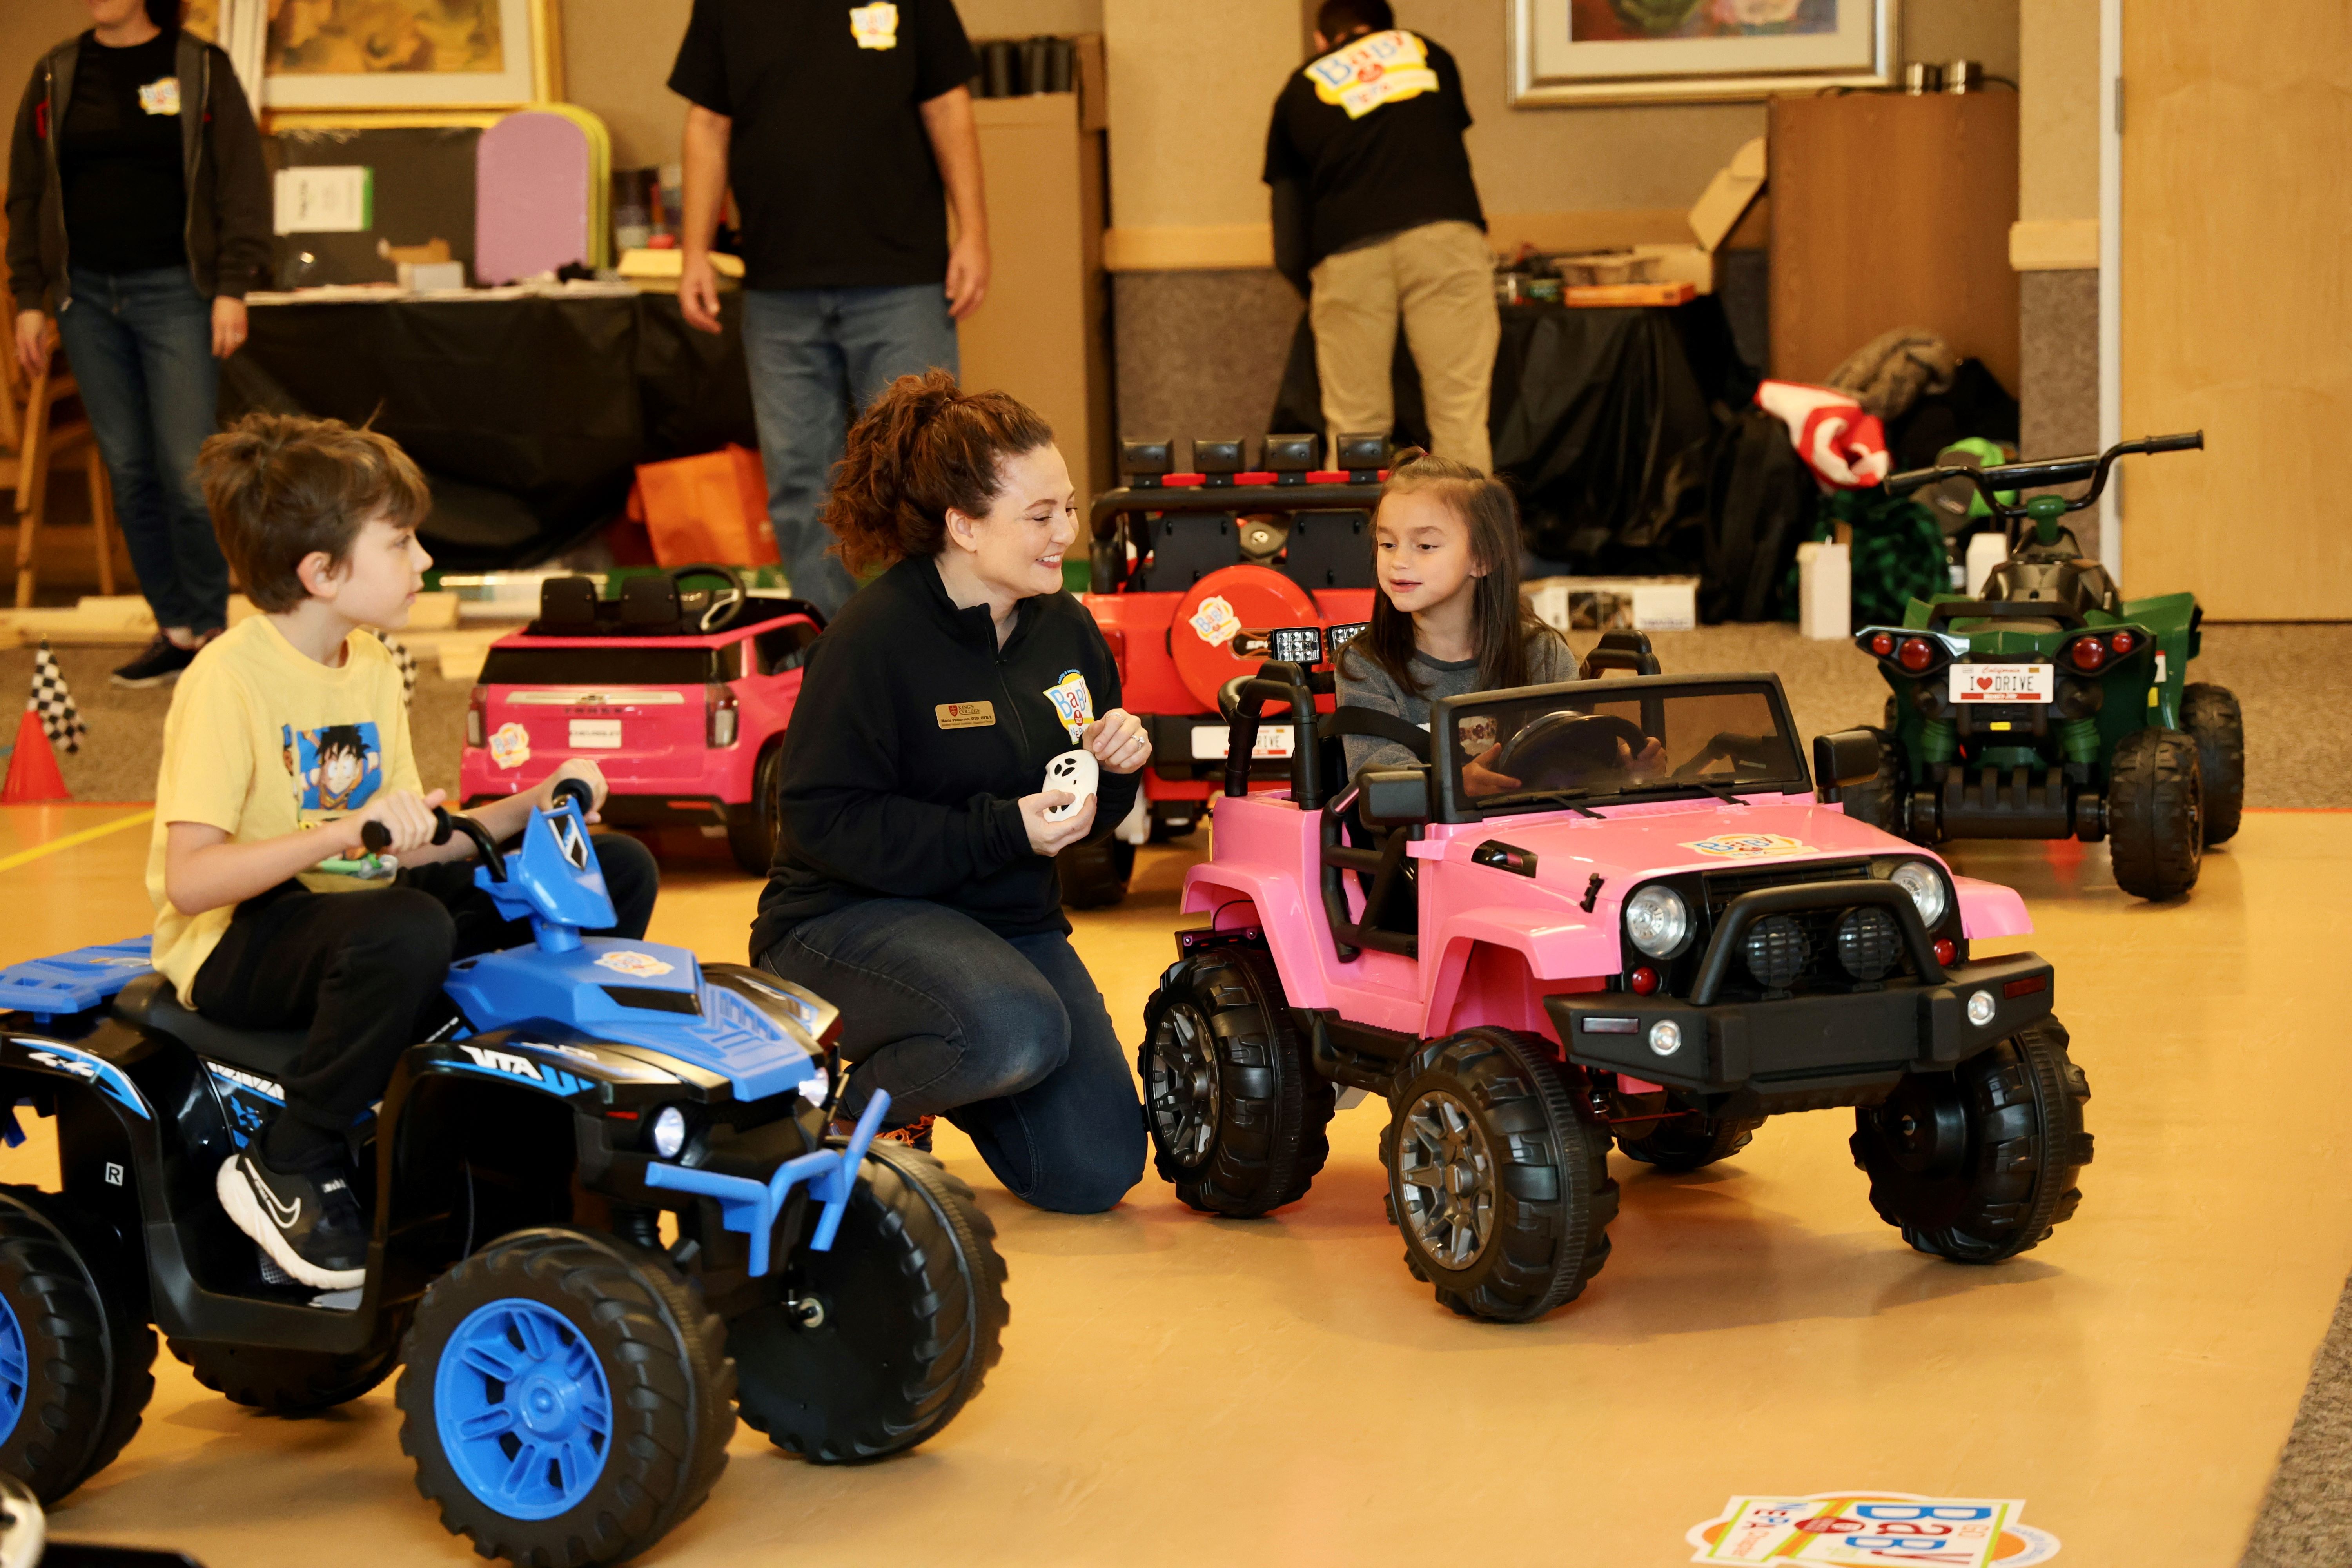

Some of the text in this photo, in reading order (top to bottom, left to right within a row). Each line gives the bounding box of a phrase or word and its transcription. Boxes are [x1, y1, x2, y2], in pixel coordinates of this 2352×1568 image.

[1995, 676, 2034, 691] DRIVE
[1071, 728, 1083, 739] NEP
[109, 1166, 120, 1183] R
